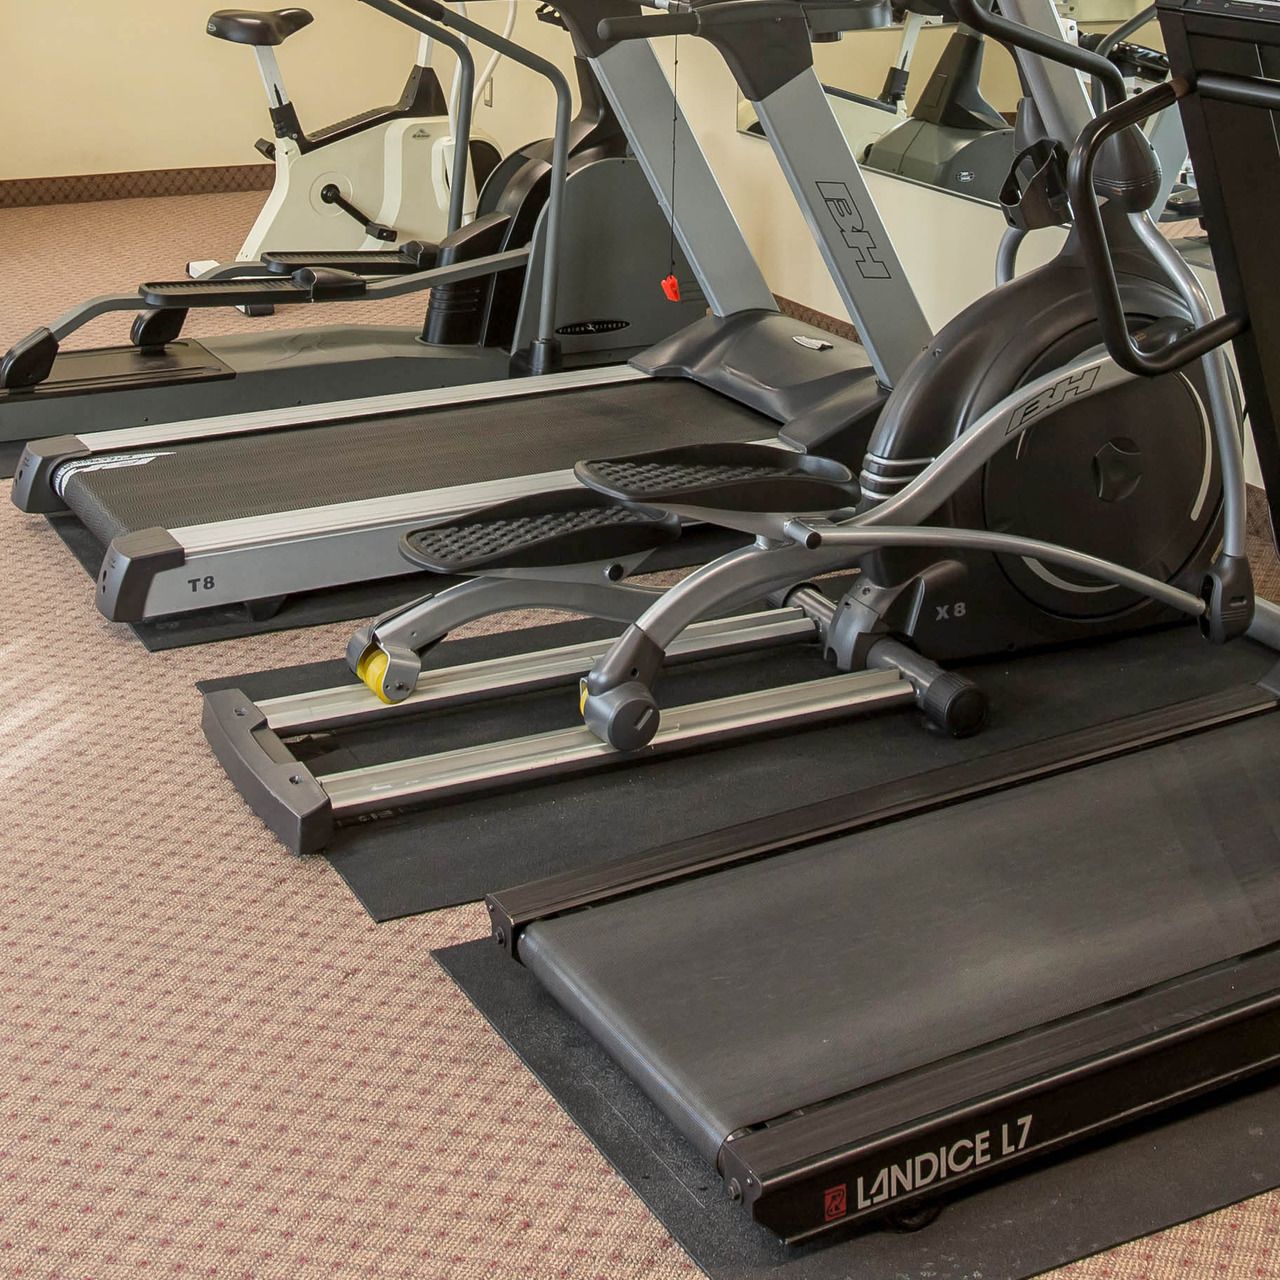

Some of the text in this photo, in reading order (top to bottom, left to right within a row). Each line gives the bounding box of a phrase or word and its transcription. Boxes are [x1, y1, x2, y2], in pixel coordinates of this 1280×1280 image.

[1004, 365, 1102, 437] BH
[857, 1114, 1034, 1210] LANDICE L7
